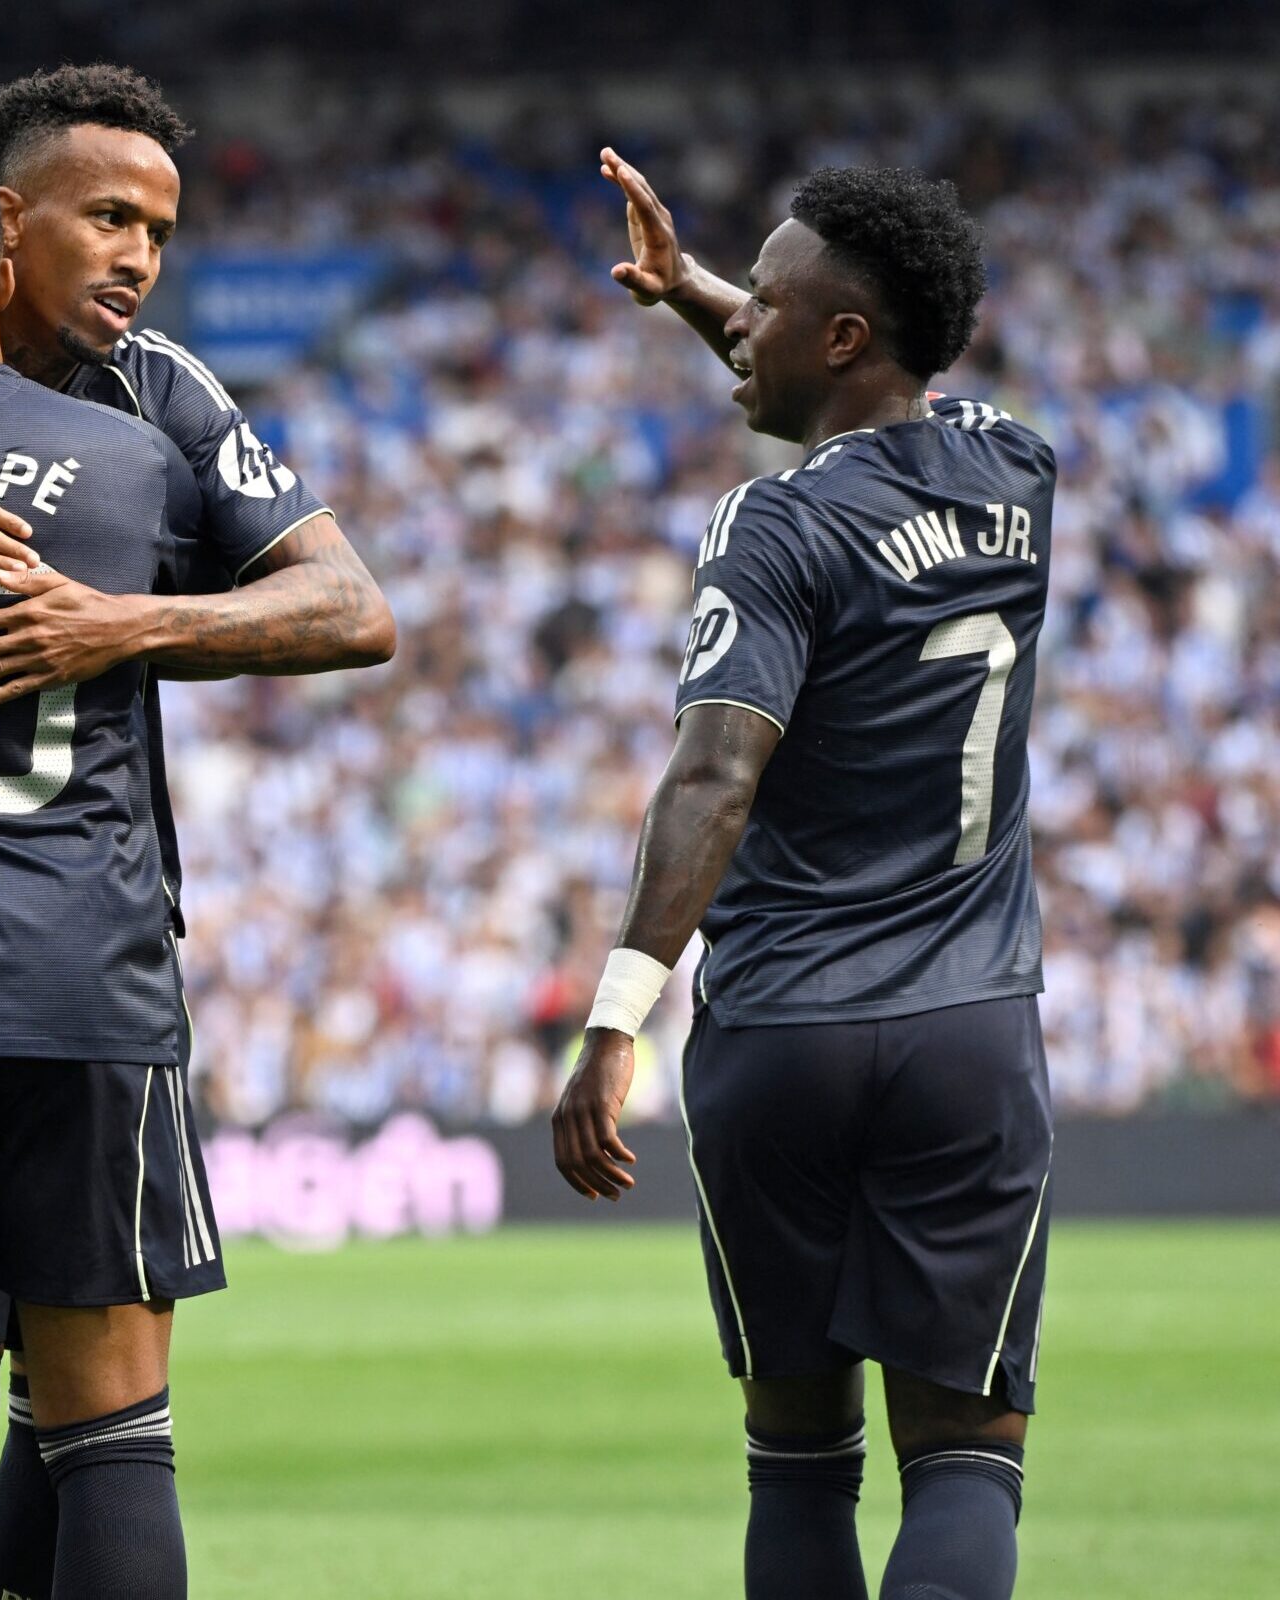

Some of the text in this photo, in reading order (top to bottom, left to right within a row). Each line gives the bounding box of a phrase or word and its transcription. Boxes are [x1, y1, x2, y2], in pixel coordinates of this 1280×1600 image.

[876, 503, 1038, 583] VINI JR.
[918, 611, 1017, 866] 7
